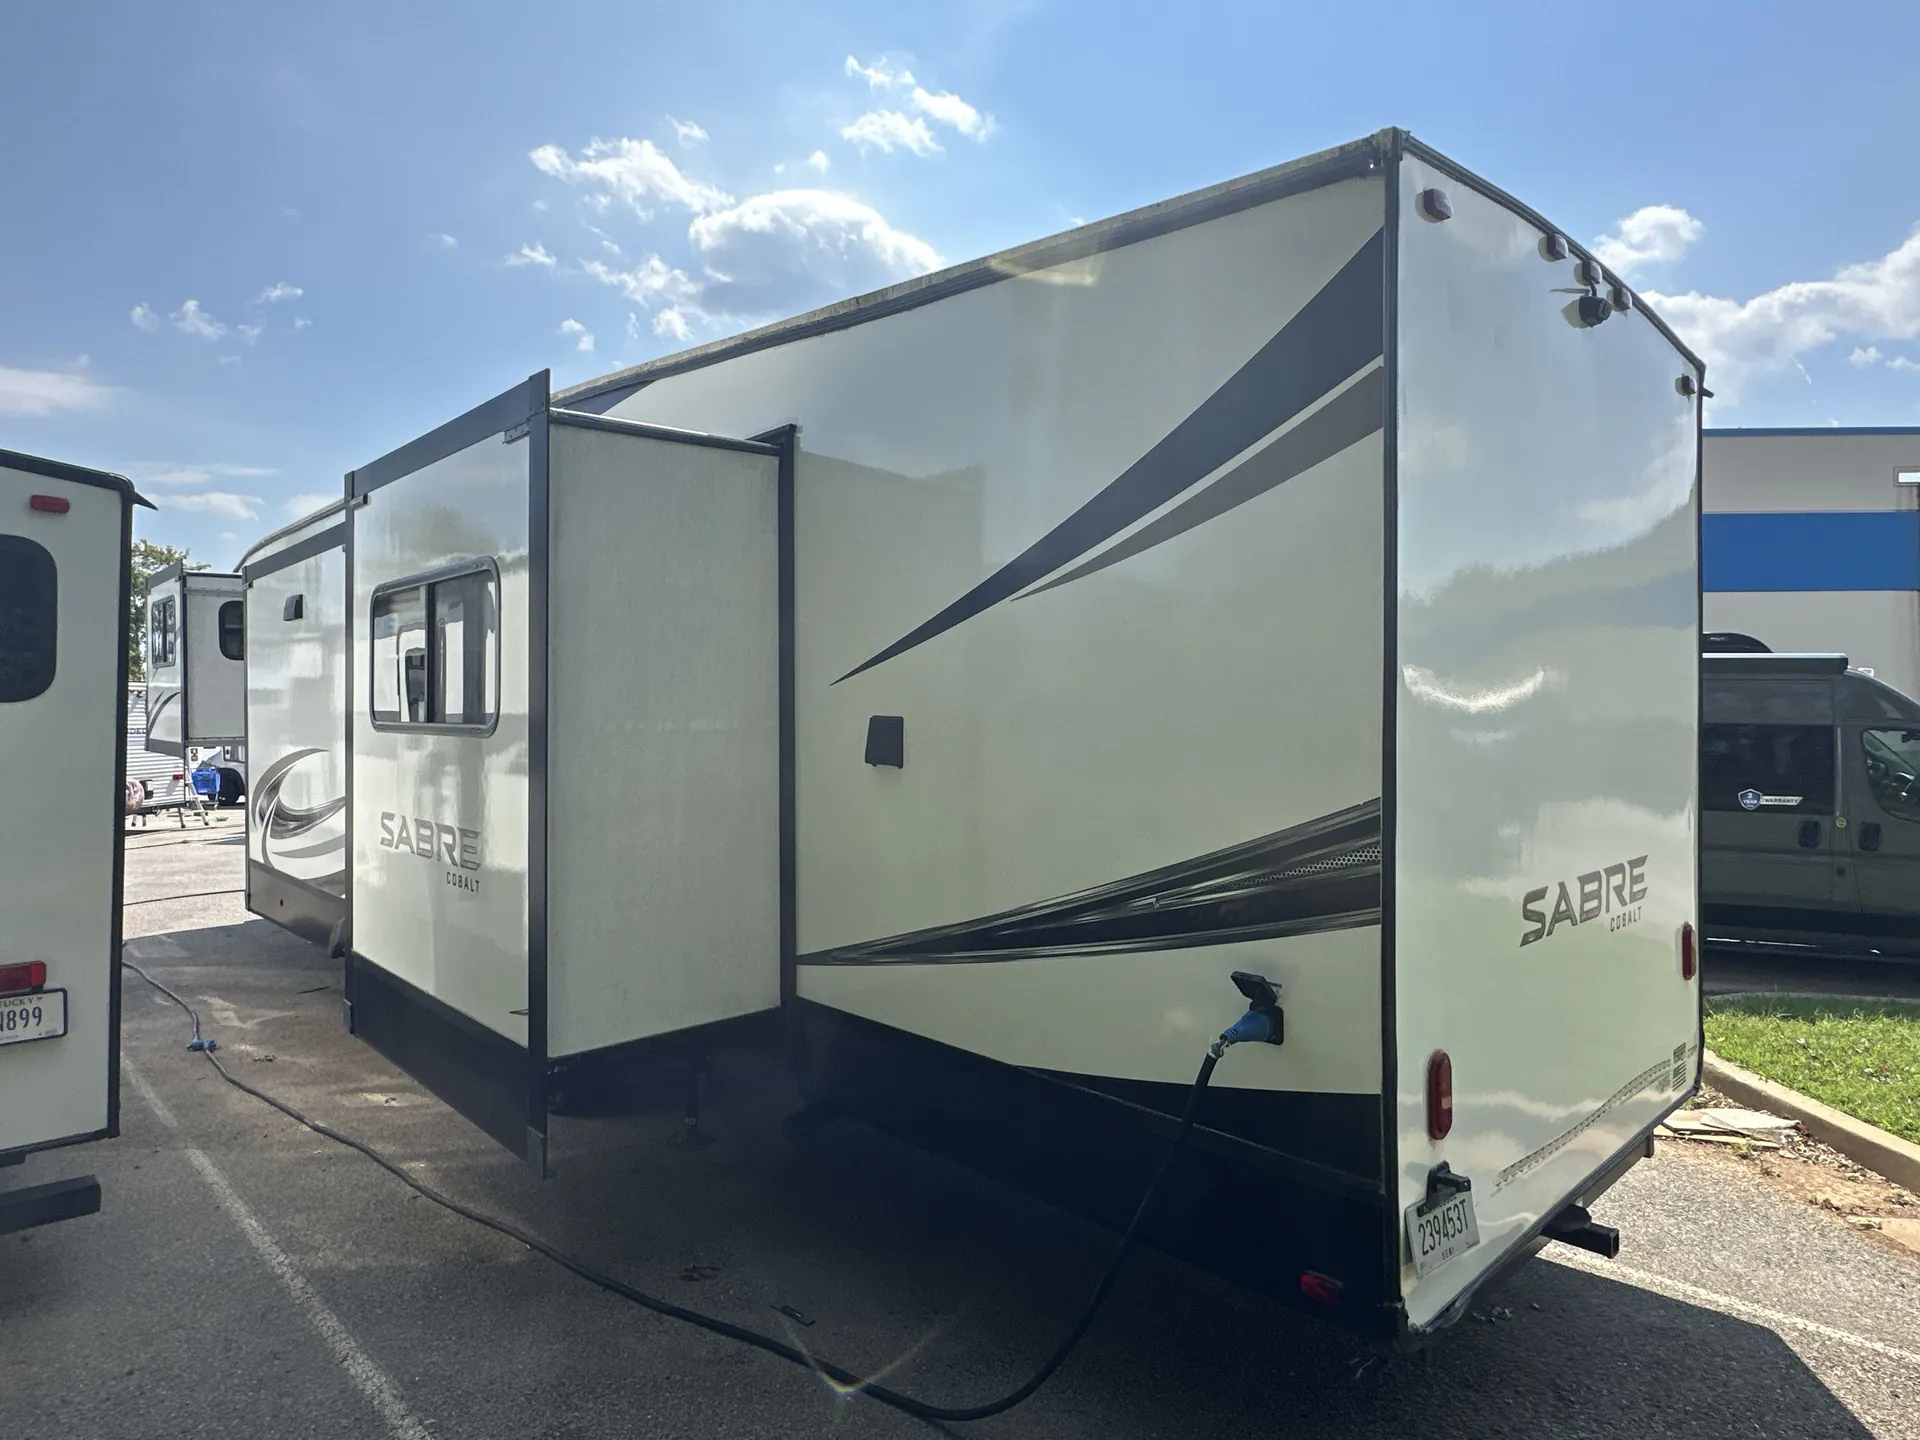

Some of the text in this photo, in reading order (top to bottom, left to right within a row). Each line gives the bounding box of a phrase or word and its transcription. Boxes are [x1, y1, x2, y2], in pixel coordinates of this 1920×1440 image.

[380, 811, 481, 871] SABRE
[446, 871, 480, 893] COBALT
[1519, 854, 1648, 948] SABRE
[1610, 906, 1642, 932] COBALT
[1418, 1198, 1469, 1256] 239453T
